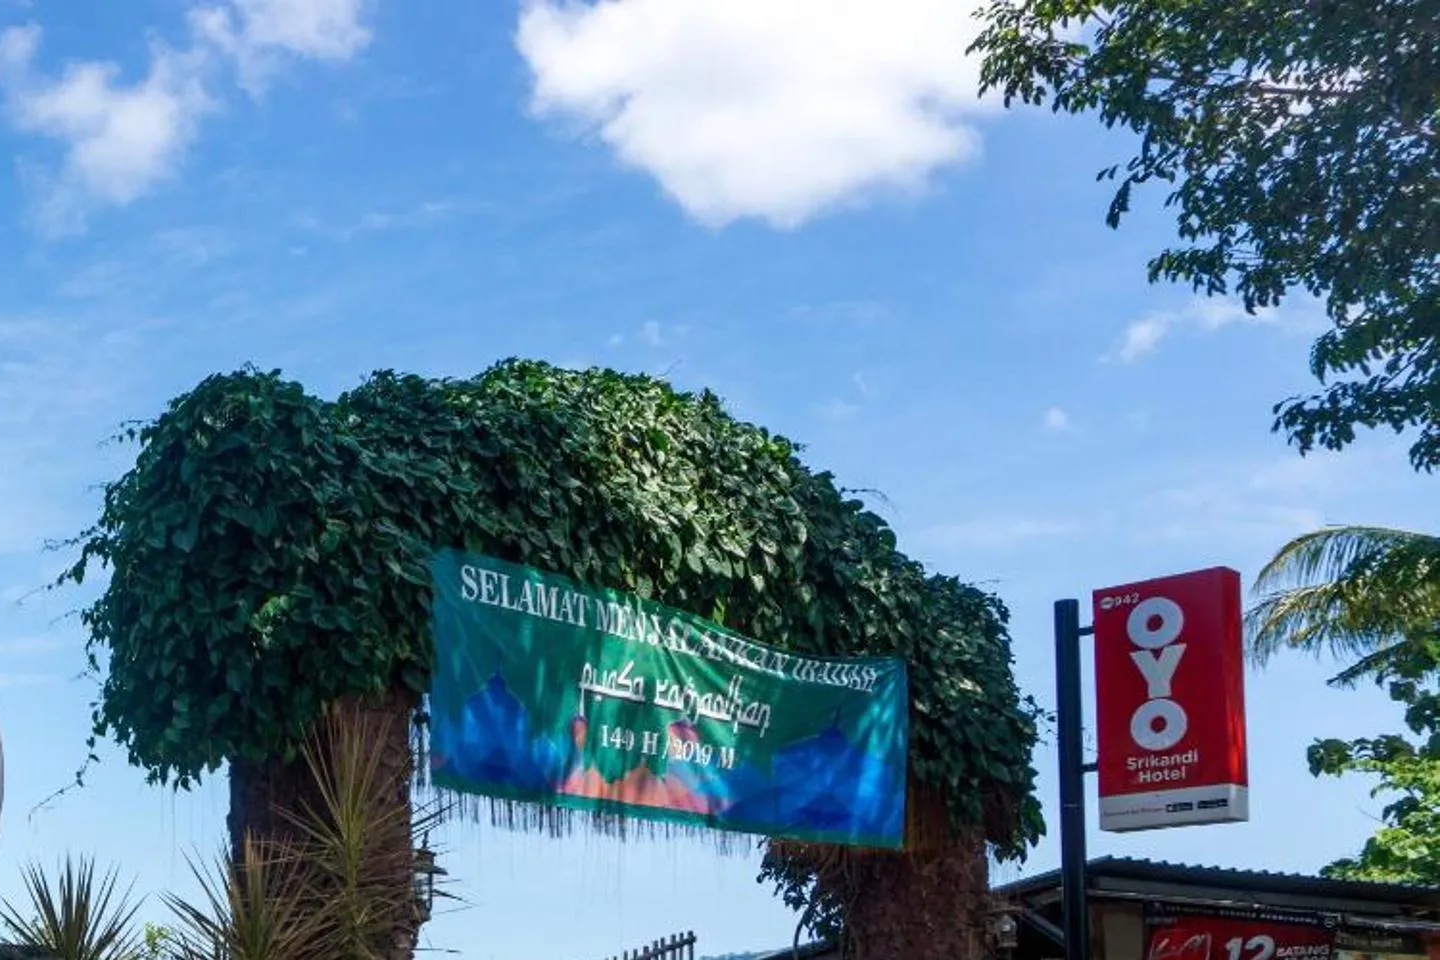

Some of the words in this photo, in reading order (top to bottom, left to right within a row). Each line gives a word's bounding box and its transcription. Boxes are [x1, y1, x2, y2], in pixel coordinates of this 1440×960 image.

[460, 564, 589, 627] SELAMAT
[1126, 596, 1188, 751] OYO
[641, 730, 659, 755] H
[1127, 749, 1199, 771] Srikandi
[1139, 766, 1187, 783] Hotel
